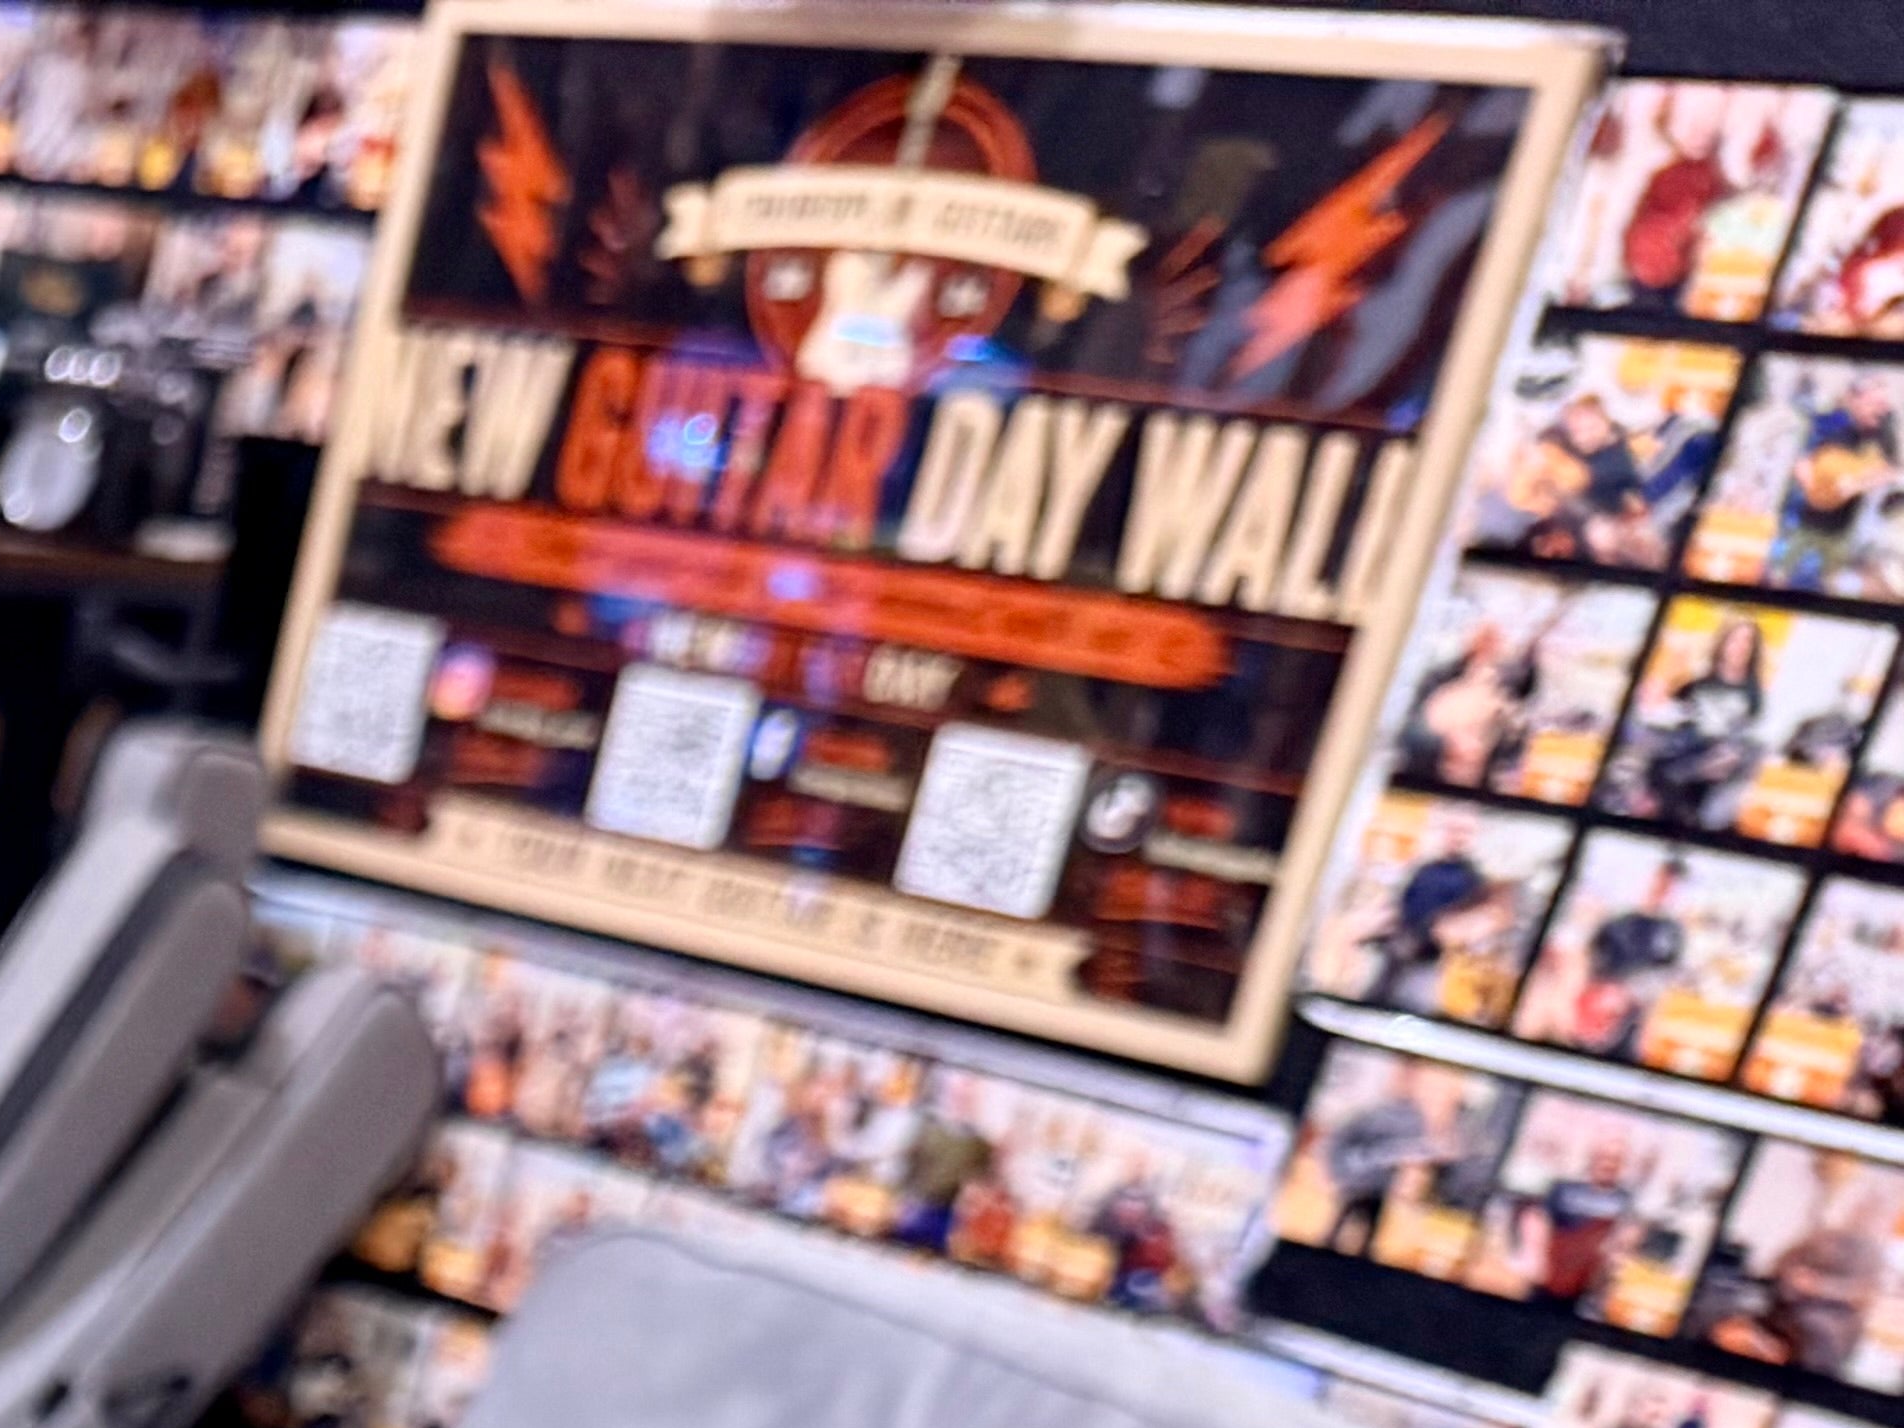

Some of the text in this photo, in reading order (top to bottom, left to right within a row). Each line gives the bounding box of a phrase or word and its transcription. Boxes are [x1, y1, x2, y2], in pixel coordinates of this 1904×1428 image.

[369, 330, 576, 500] NEW
[556, 346, 908, 545] GUITAR
[896, 391, 1130, 580] DAY
